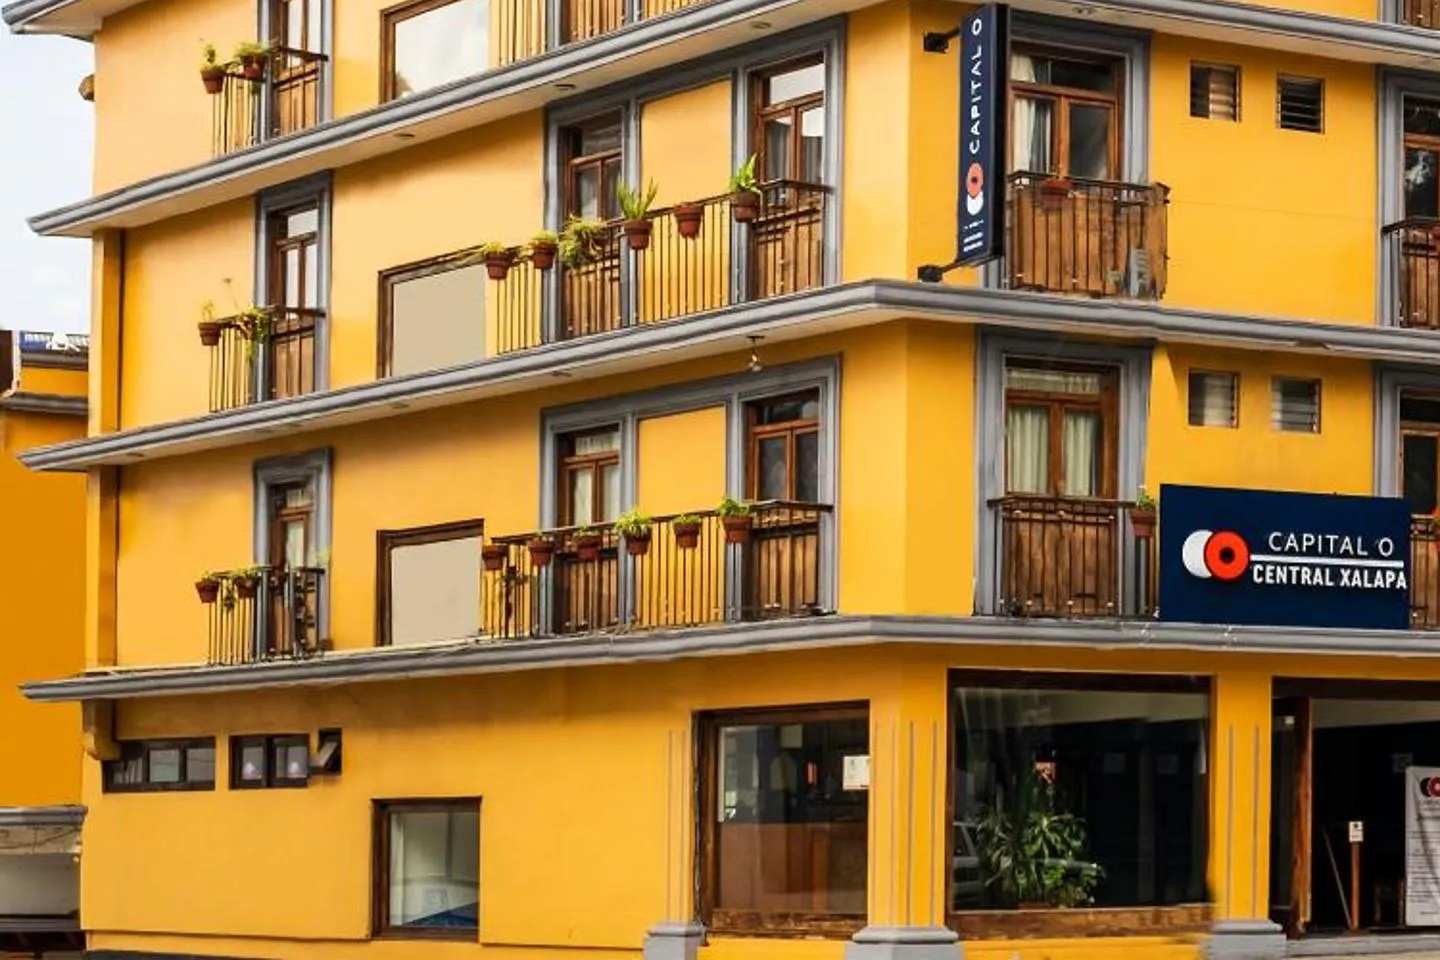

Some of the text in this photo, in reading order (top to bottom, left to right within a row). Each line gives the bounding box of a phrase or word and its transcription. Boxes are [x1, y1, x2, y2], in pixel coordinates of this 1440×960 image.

[968, 17, 984, 155] CAPITAL O
[1268, 531, 1395, 558] CAPITAL O
[1252, 563, 1408, 590] CENTRAL XALAPA
